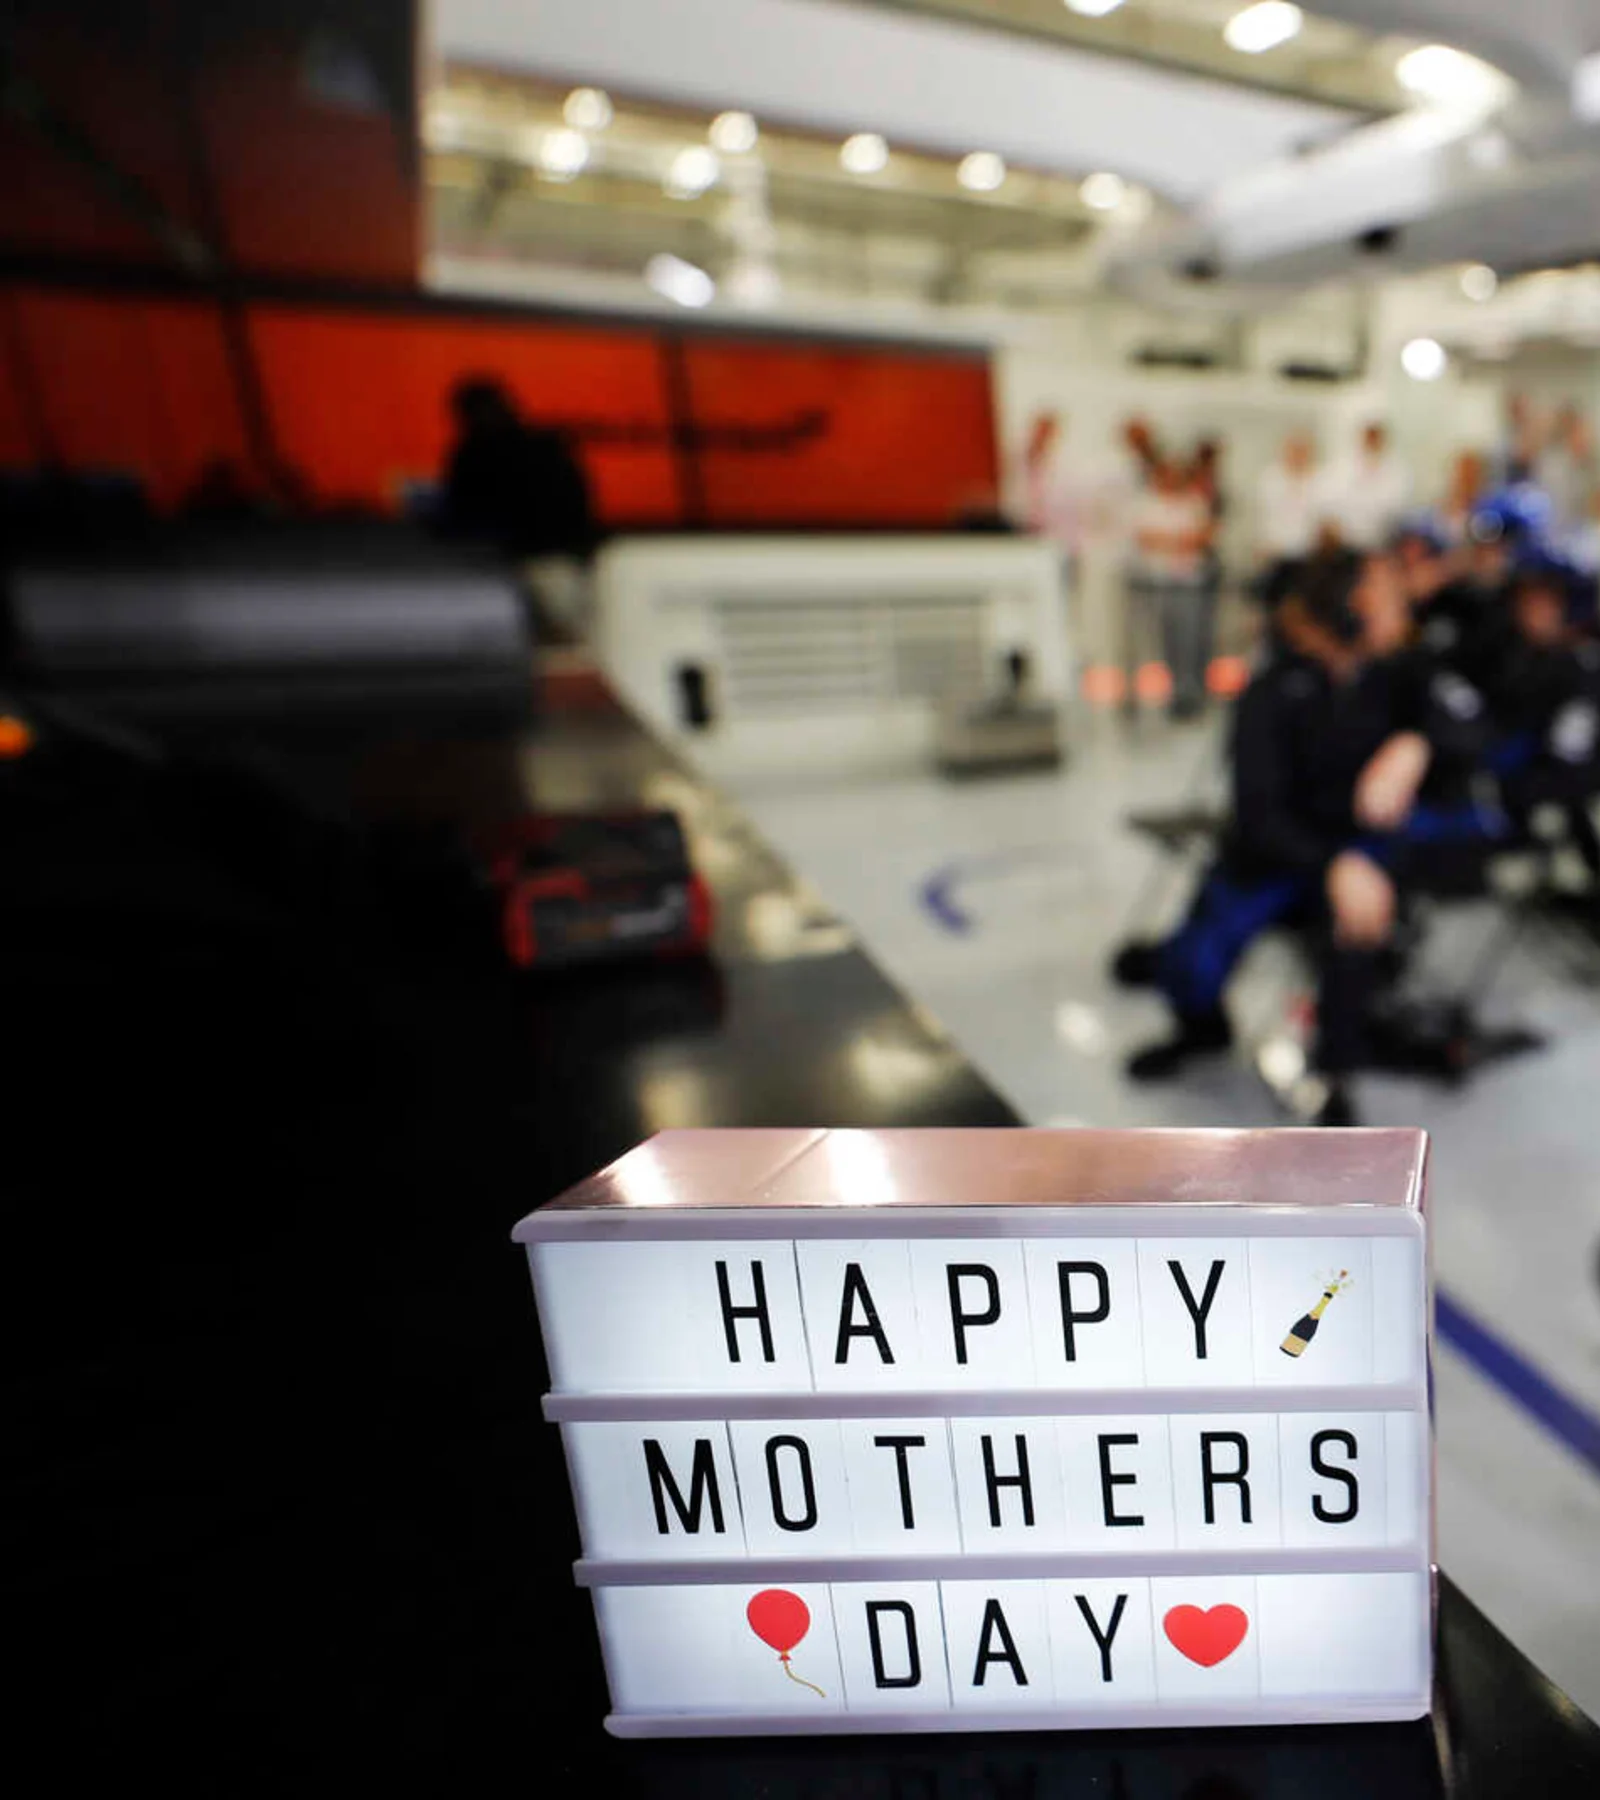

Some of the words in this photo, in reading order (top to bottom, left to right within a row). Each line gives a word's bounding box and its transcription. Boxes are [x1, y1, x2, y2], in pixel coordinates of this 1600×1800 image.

[715, 1260, 1226, 1365] HAPPY
[642, 1429, 1359, 1535] MOTHERS
[865, 1594, 1128, 1689] DAY
